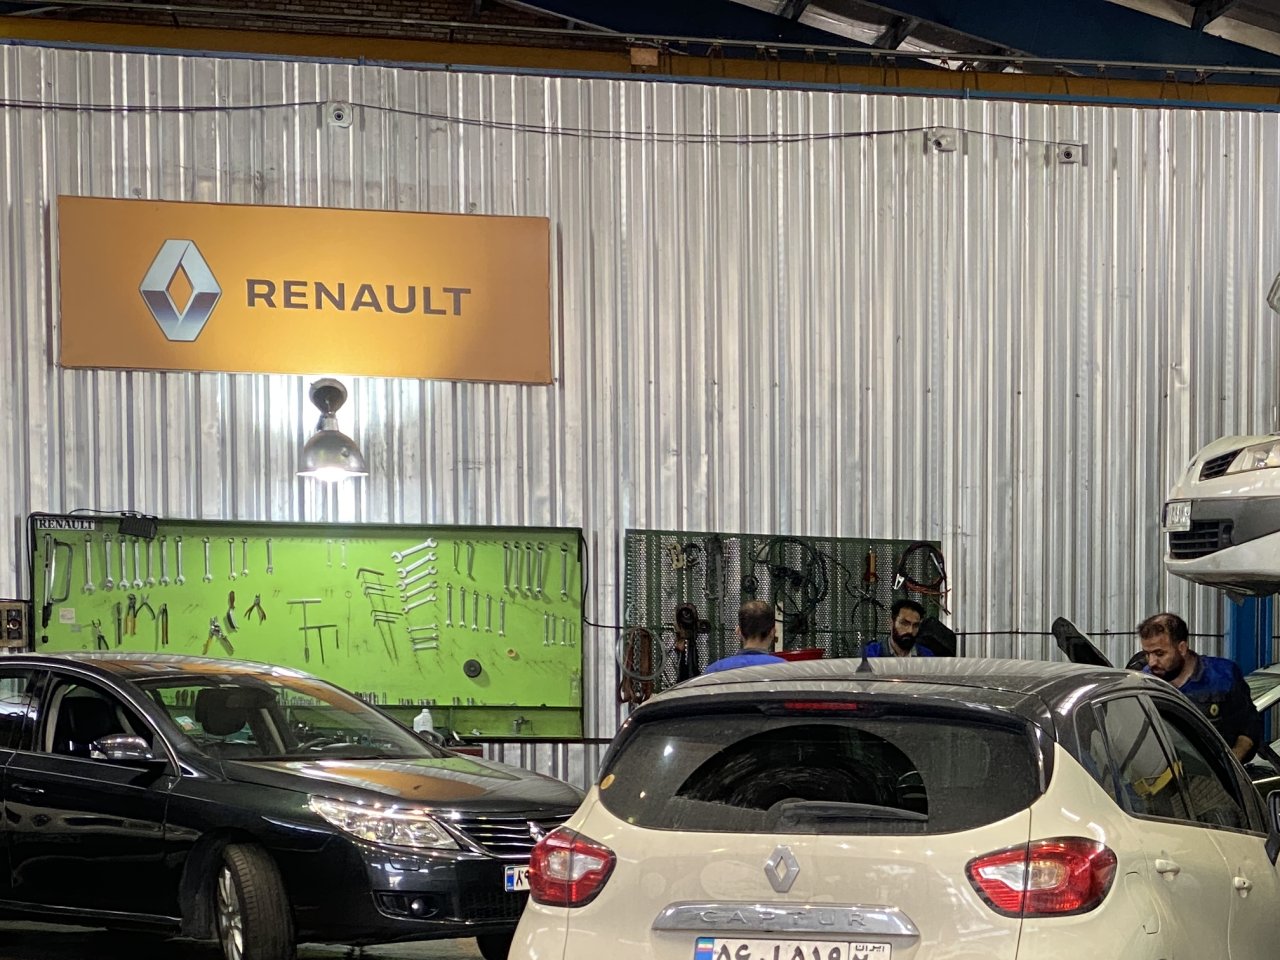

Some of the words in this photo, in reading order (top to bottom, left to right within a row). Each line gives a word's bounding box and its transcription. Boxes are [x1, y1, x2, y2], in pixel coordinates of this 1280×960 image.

[246, 278, 472, 316] RENAULT
[39, 518, 94, 530] RENAULT
[700, 910, 867, 927] CAPTUR
